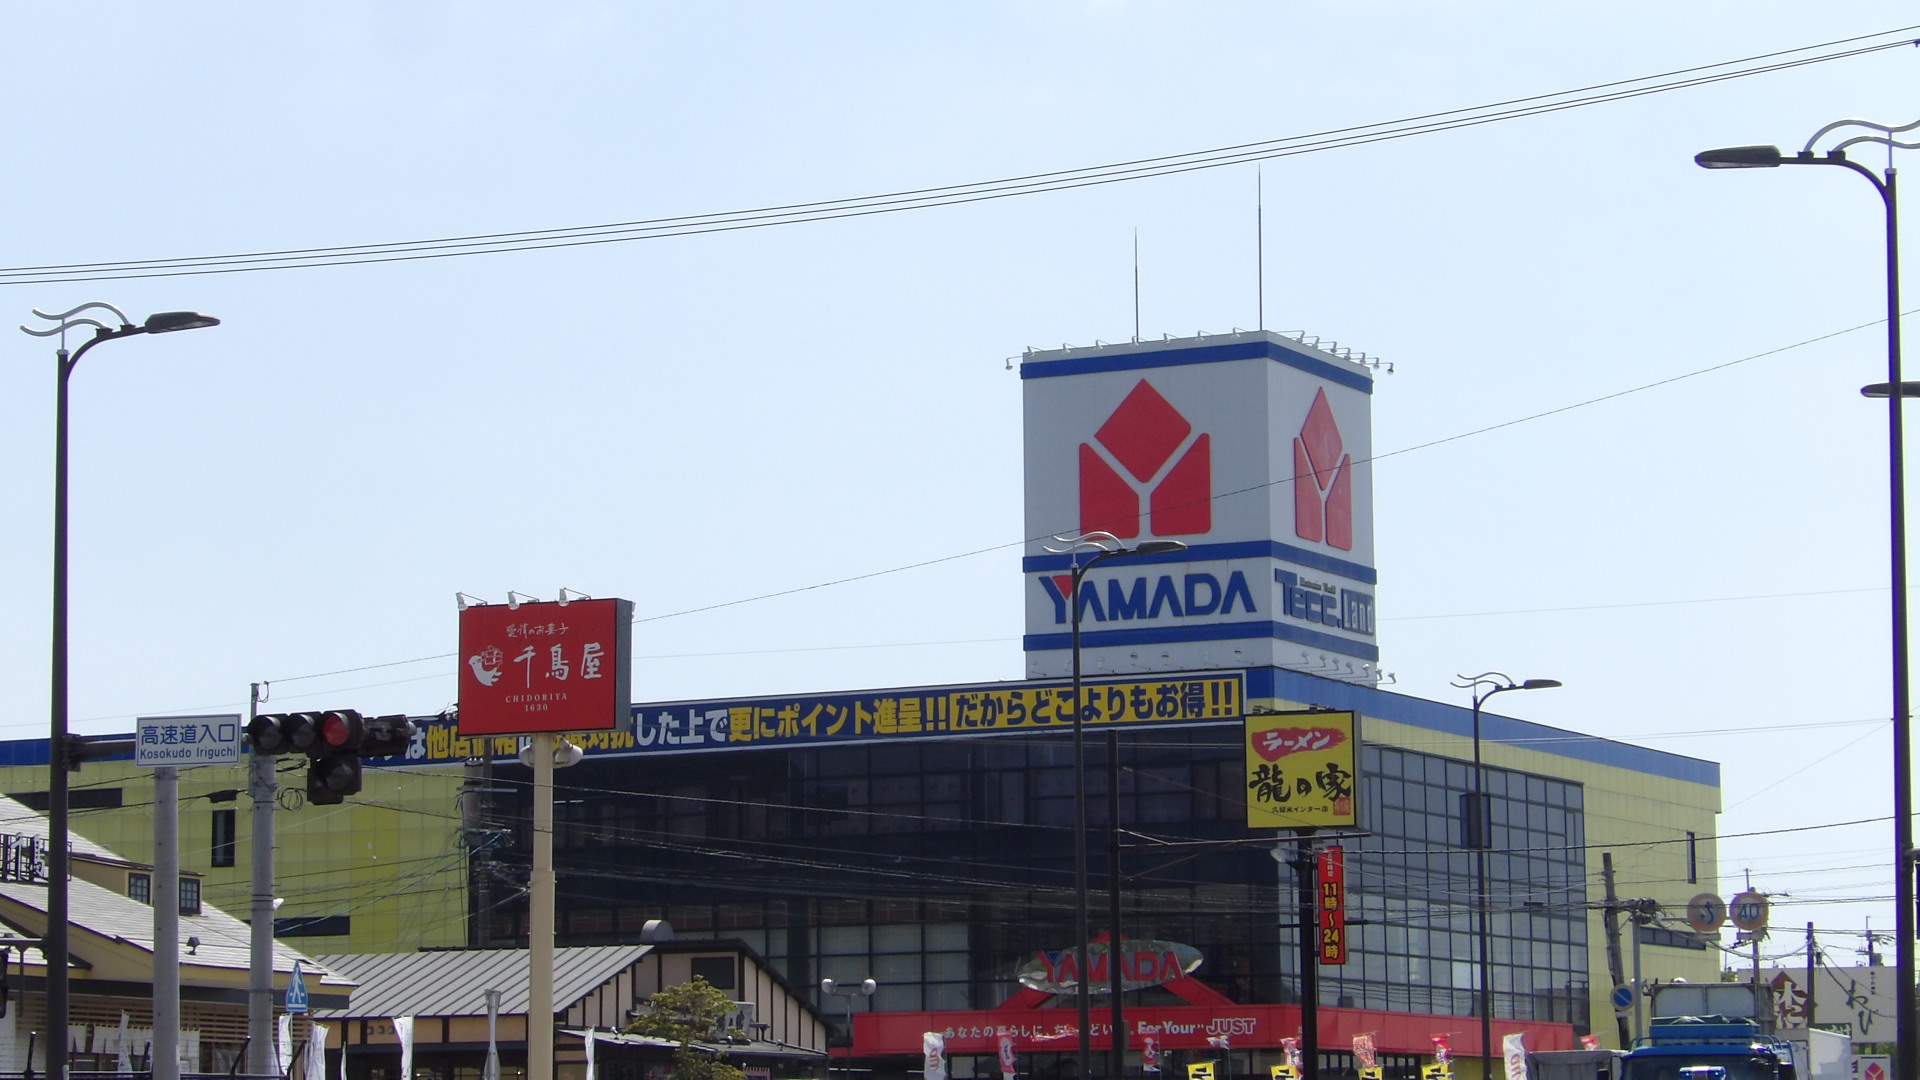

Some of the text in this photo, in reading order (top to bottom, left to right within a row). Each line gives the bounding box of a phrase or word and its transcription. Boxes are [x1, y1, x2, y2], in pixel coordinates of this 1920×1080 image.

[1039, 571, 1257, 624] YAMADA
[513, 642, 605, 689] 千鳥屋
[505, 692, 568, 703] CHIDORIYA
[524, 703, 548, 712] 1630
[141, 724, 235, 745] 高速道入口
[1262, 732, 1330, 751] ラーメン
[140, 745, 236, 760] Kosokudo Iriguchi
[1248, 762, 1352, 803] 龍の家
[1738, 903, 1760, 920] 40
[1206, 1018, 1257, 1036] JUST
